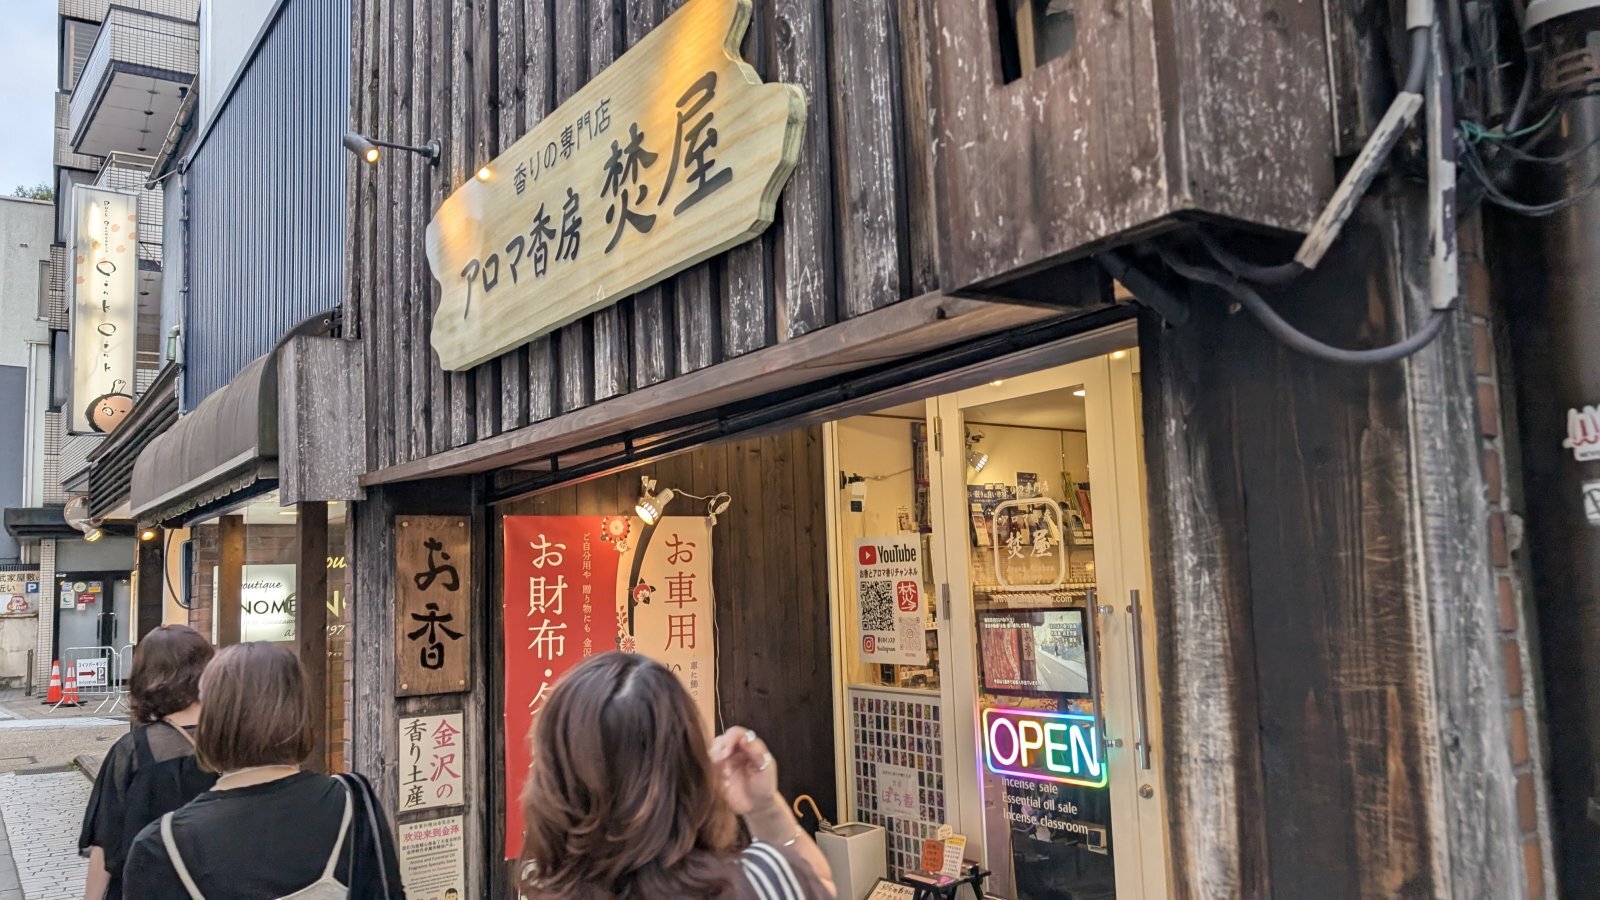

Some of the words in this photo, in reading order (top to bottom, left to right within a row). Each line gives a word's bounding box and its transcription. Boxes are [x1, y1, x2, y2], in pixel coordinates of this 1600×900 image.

[513, 98, 611, 195] 香りの専門店
[461, 187, 582, 319] アロマ香房
[600, 71, 733, 254] 焚屋
[877, 544, 917, 563] YouTube
[241, 580, 283, 592] outique
[407, 537, 464, 670] お香
[403, 719, 428, 808] 香り土産
[430, 719, 461, 799] 金沢の
[989, 717, 1101, 776] OPEN
[1001, 777, 1035, 790] Incense
[1039, 783, 1058, 794] sale
[1002, 791, 1040, 809] Essential
[1043, 798, 1055, 811] oil
[1057, 802, 1078, 815] sale
[1003, 807, 1038, 825] Incense
[1040, 816, 1088, 835] classroom
